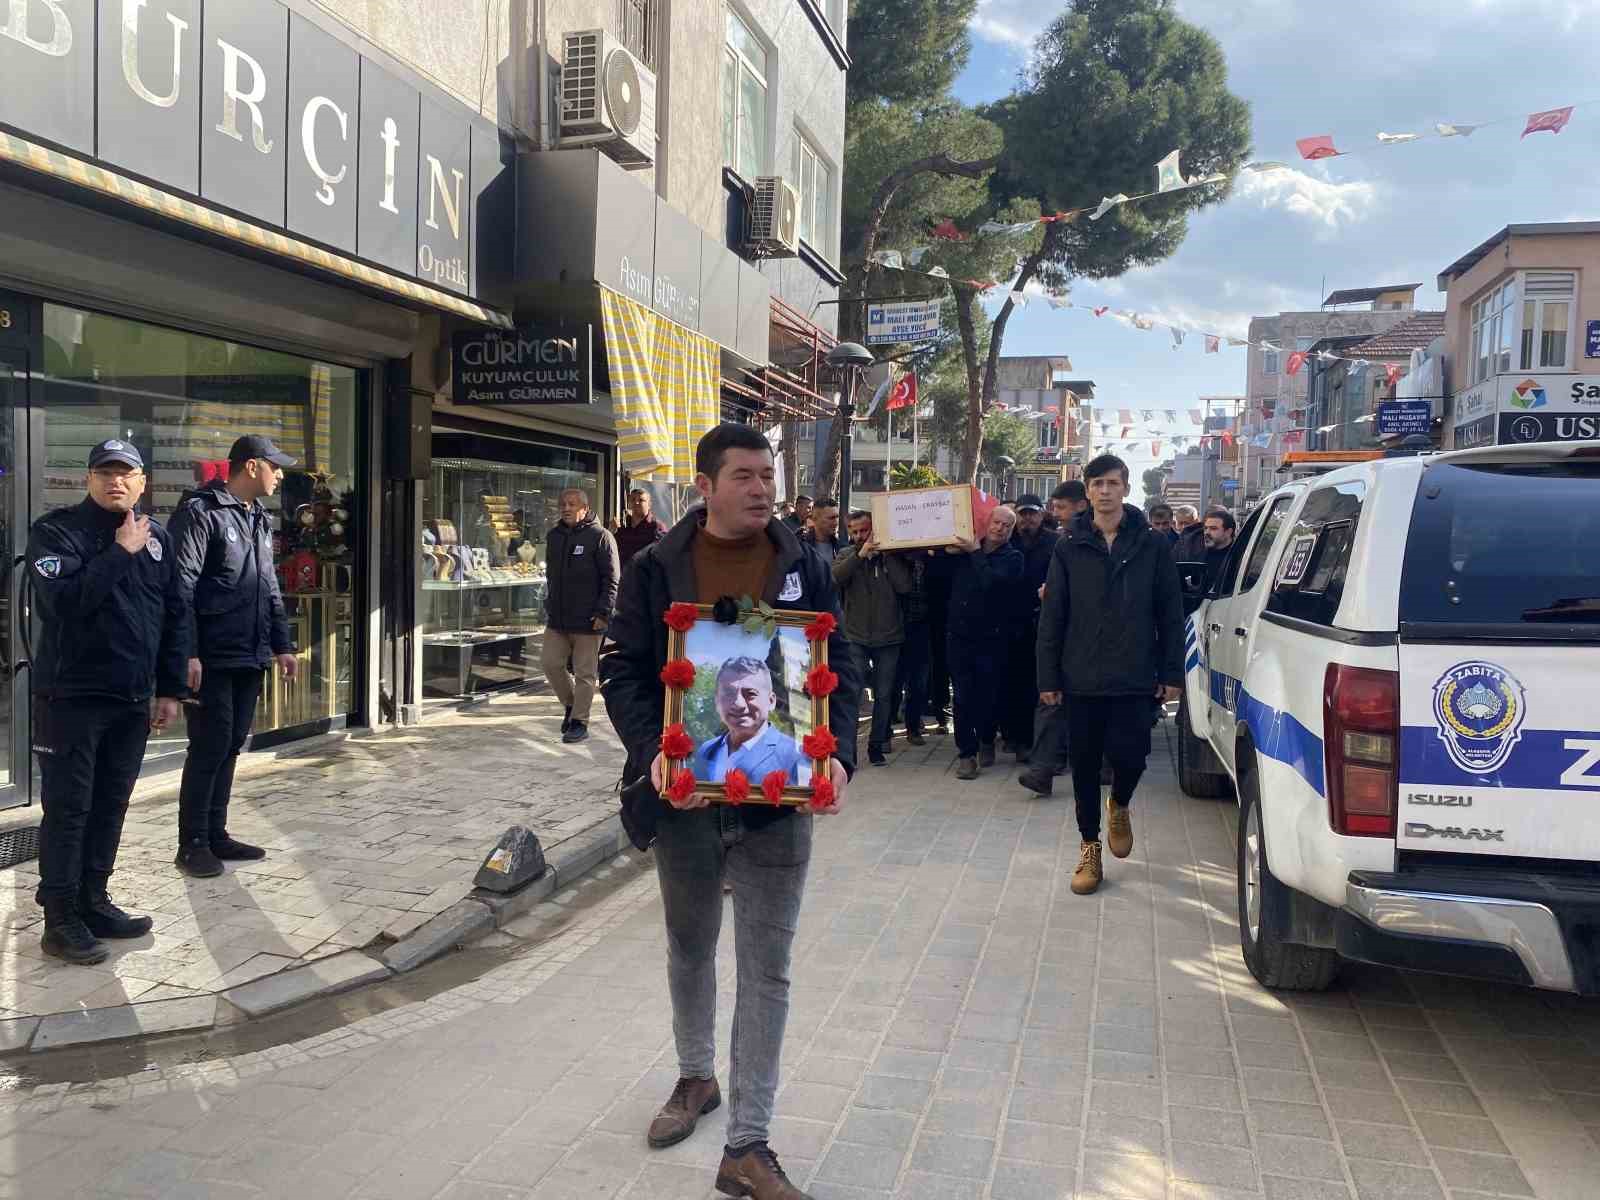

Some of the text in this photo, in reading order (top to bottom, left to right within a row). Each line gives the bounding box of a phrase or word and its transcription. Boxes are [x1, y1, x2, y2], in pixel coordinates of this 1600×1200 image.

[419, 244, 467, 287] Optik
[462, 332, 577, 365] GÜRMEN
[462, 369, 579, 384] KUYUMCULUK
[467, 387, 577, 400] Asım GÜRMEN
[1456, 666, 1501, 681] ZABITA
[1405, 822, 1504, 841] D-MAX
